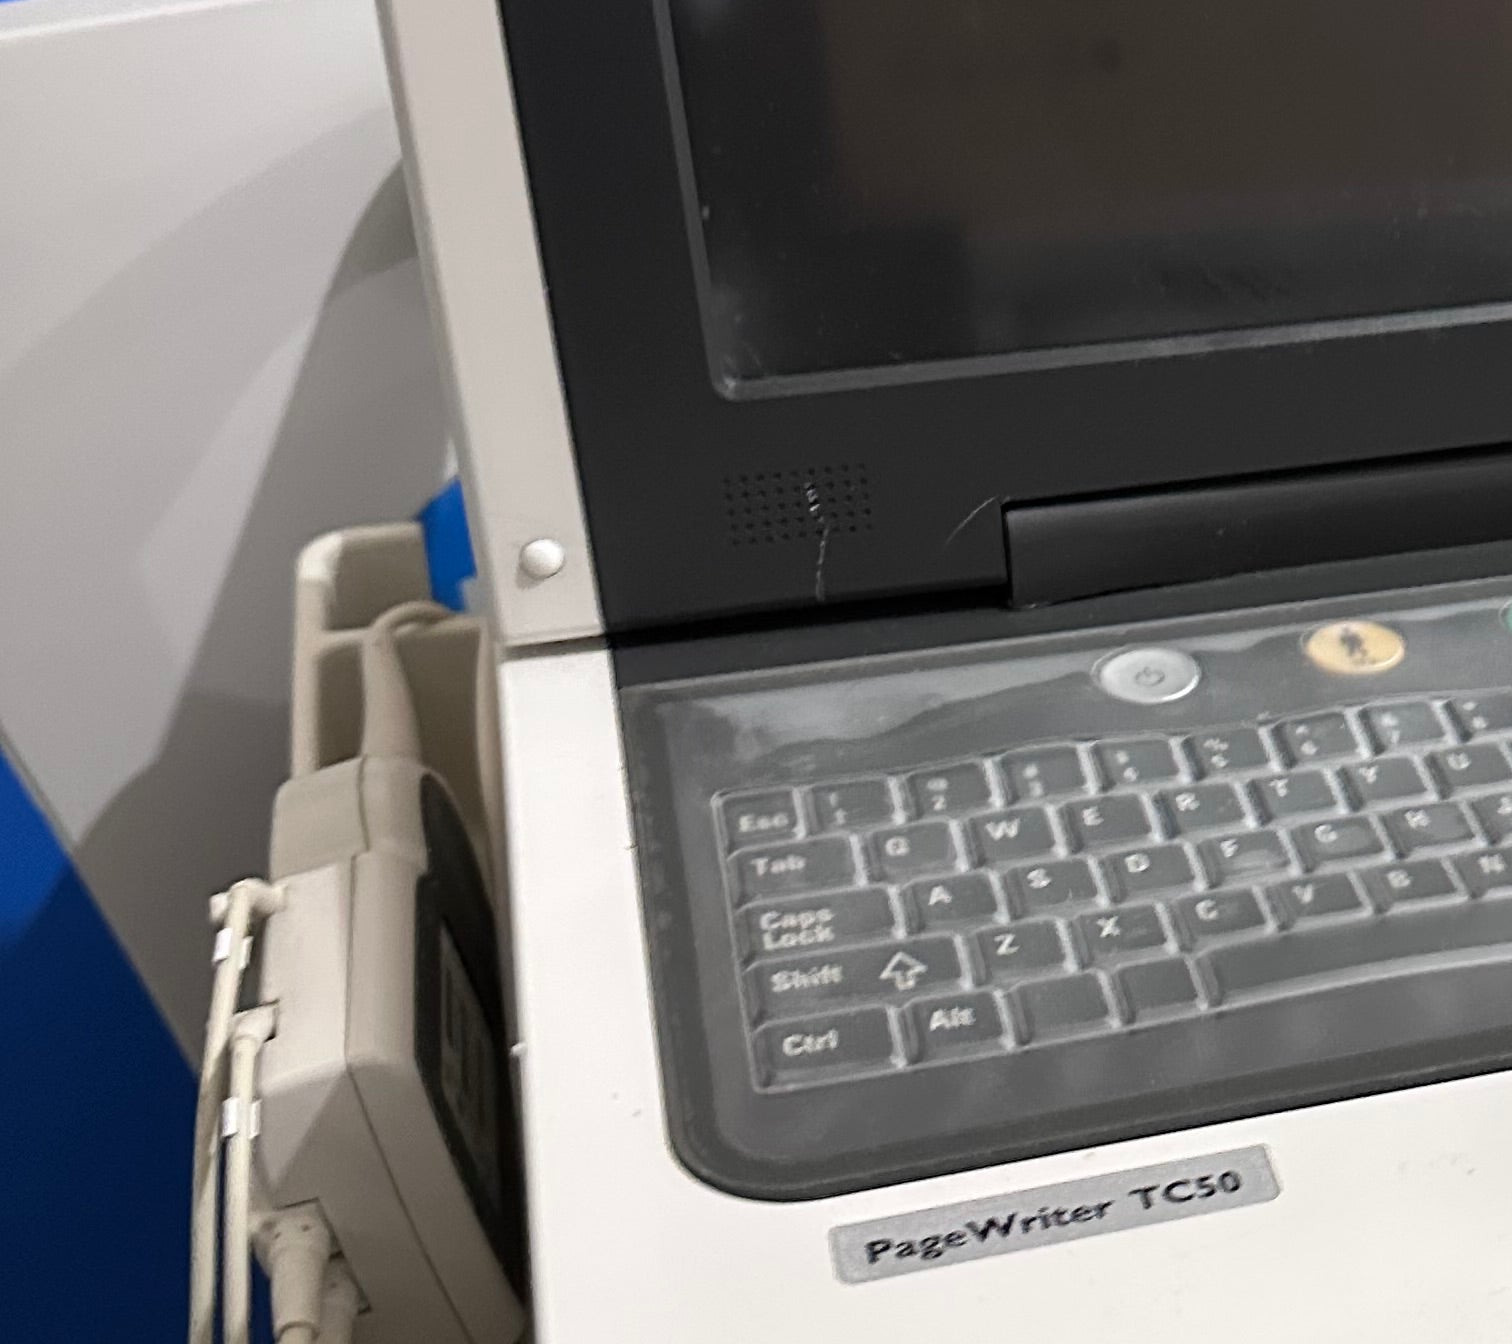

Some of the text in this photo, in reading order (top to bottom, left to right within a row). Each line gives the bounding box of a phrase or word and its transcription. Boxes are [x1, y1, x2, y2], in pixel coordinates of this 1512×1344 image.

[1446, 752, 1472, 771] U
[1358, 765, 1379, 784] Y
[1269, 778, 1289, 798] T
[1175, 791, 1200, 812] R
[738, 812, 789, 833] Esc
[1082, 806, 1104, 827] E
[1404, 809, 1431, 829] H
[984, 817, 1021, 841] W
[1314, 824, 1338, 843] G
[885, 836, 910, 857] Q
[1219, 838, 1239, 858] F
[751, 854, 807, 877] Tab
[1124, 853, 1150, 874] D
[1477, 854, 1506, 874] N
[1026, 868, 1052, 889] S
[1386, 869, 1413, 889] B
[927, 885, 953, 906] A
[1292, 883, 1315, 904] V
[760, 907, 836, 931] Caps
[1195, 899, 1219, 921] C
[1096, 915, 1121, 939] X
[762, 925, 836, 951] Lock
[993, 933, 1021, 956] Z
[770, 964, 843, 993] Shift
[929, 1006, 977, 1032] Alt
[782, 1028, 839, 1057] Ctrl
[862, 1168, 1243, 1267] PageWriter TC50
